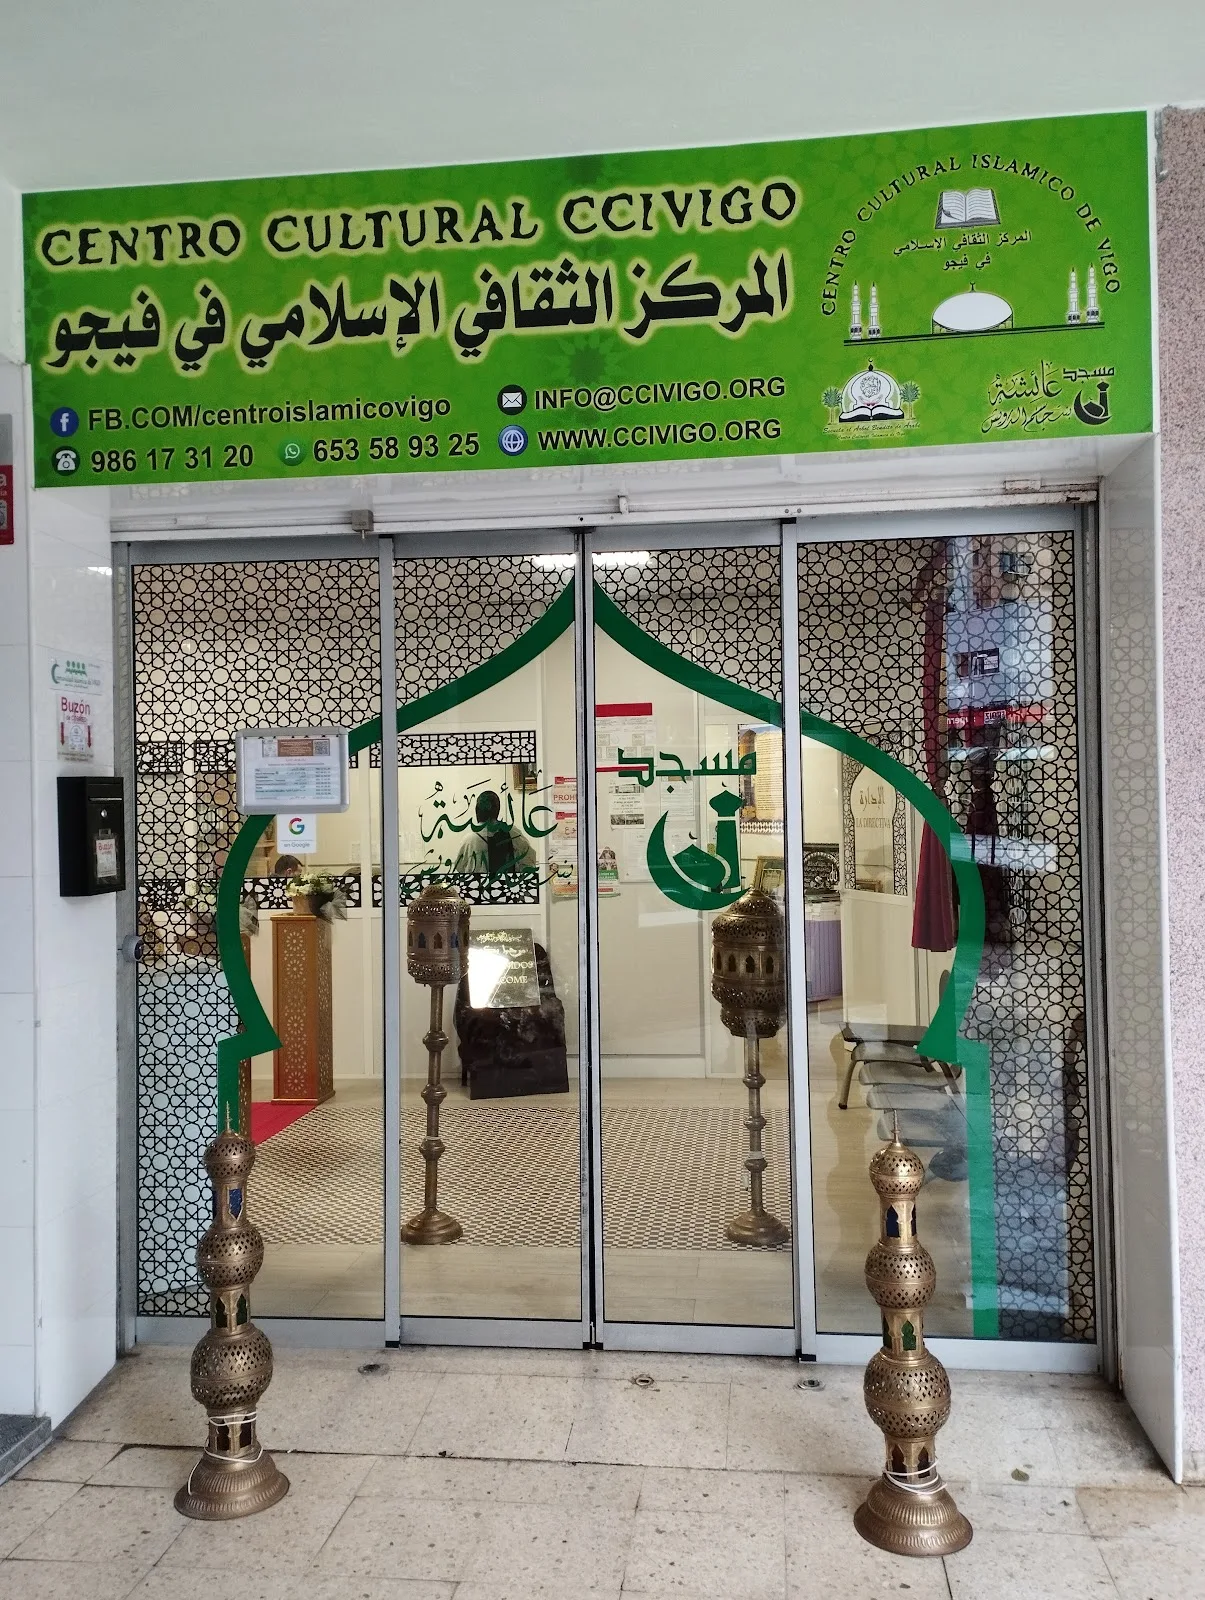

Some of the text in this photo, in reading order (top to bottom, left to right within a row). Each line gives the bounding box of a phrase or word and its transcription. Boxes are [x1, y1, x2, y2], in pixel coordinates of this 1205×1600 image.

[41, 182, 796, 267] CENTRO CULTURAL CCIVIGO
[821, 154, 1121, 317] CENTRO CULTURAL ISLAMICO DE VIGO
[996, 230, 1032, 247] المركز
[952, 232, 990, 251] الثقافي
[943, 252, 991, 271] في فيجو
[46, 253, 788, 371] المركز الثقافي الإسلامي في فيجو
[1063, 366, 1115, 384] مسجد
[535, 376, 786, 411] INFO@CCIVIGO.ORG
[88, 397, 451, 431] FB.COM/centroislamicovigo
[313, 432, 480, 463] 653 58 93 25
[538, 418, 781, 451] WWW.CCIVIGO.ORG
[91, 445, 254, 473] 986 17 31 20
[61, 696, 91, 715] Buzón
[617, 747, 757, 793] مسجد
[291, 841, 310, 849] Google
